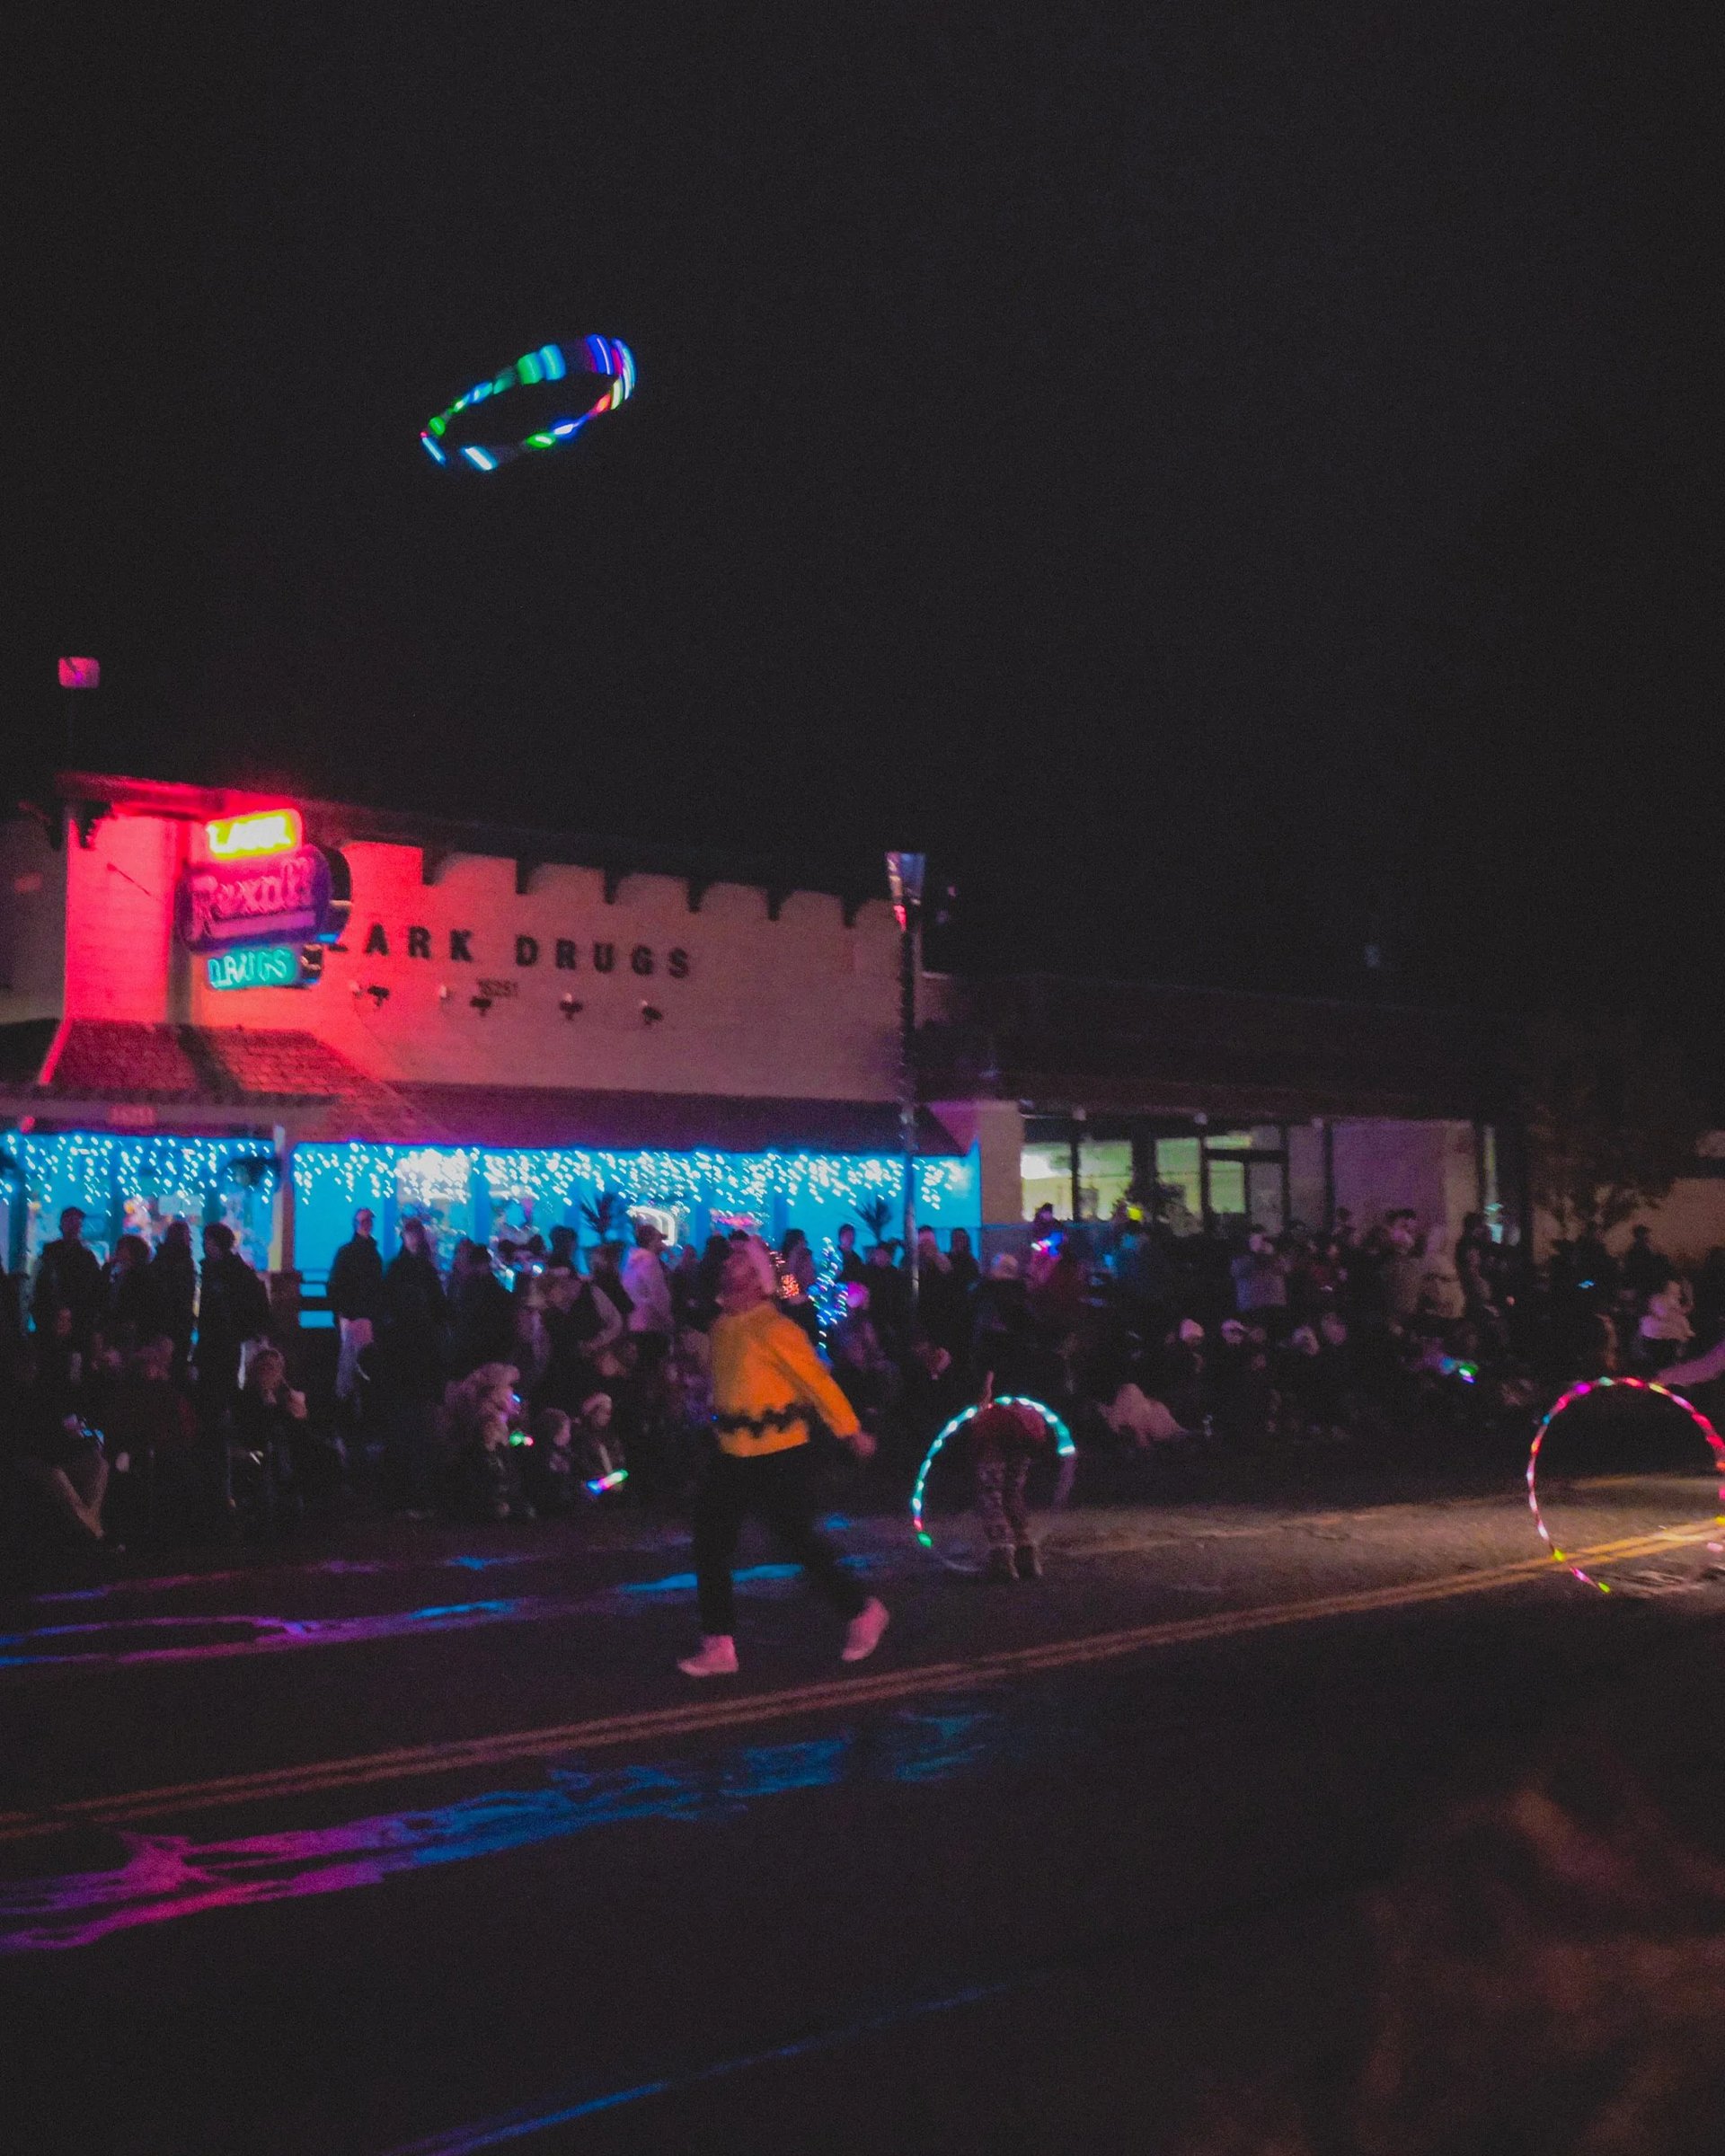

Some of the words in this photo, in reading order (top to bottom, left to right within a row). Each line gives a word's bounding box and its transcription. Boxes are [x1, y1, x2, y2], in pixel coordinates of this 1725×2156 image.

[208, 949, 288, 989] DRUGS
[328, 923, 474, 963] ARK
[515, 933, 690, 979] DRUGS
